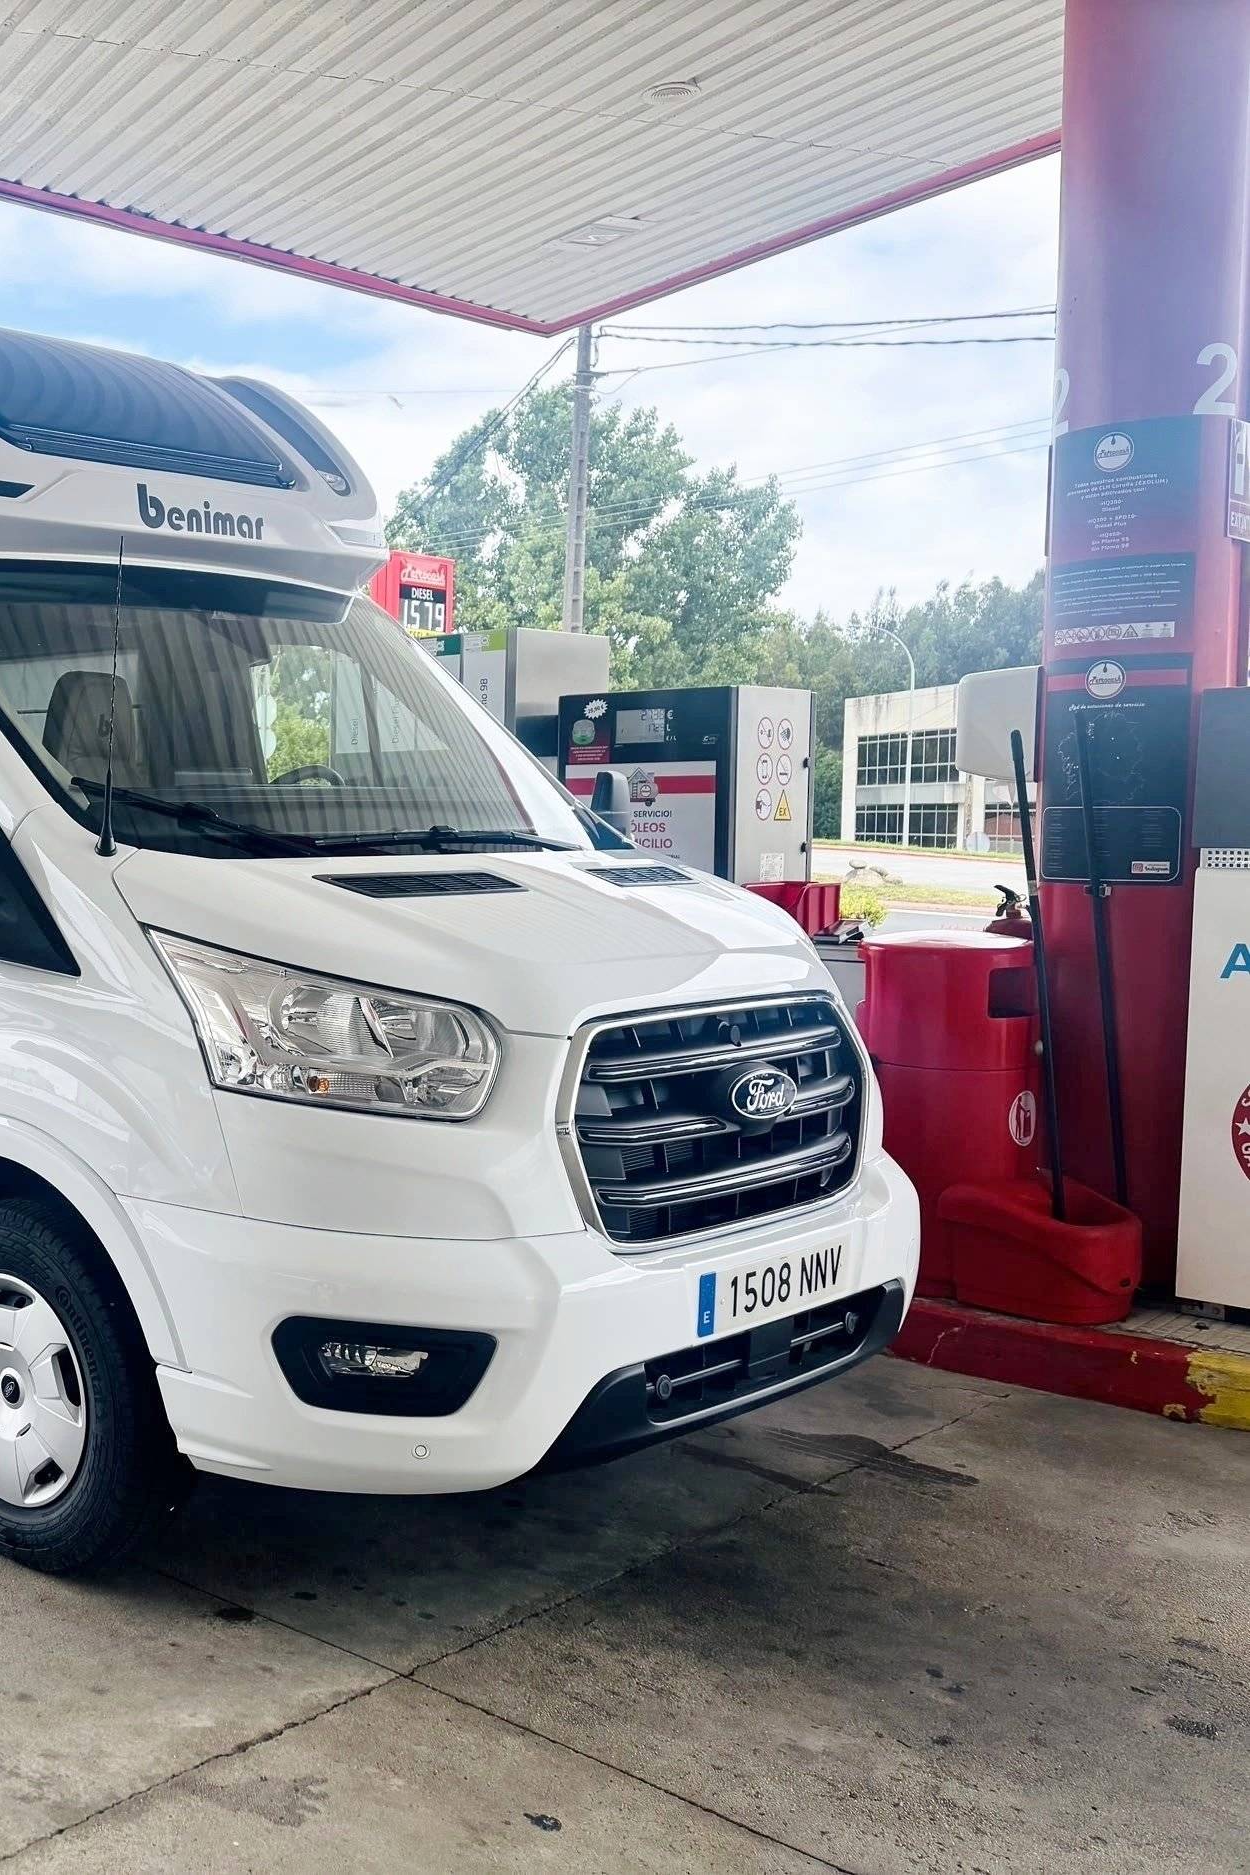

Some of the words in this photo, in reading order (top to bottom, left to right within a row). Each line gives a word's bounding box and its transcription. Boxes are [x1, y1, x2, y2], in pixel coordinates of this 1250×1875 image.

[1193, 342, 1237, 415] 2
[137, 483, 264, 541] benimar
[411, 587, 434, 600] DIESEL
[633, 810, 672, 818] SERVICIO!
[779, 808, 787, 817] EX
[746, 1078, 786, 1112] Ford
[703, 1310, 711, 1324] E
[730, 1262, 792, 1318] 1508
[800, 1244, 842, 1297] NNV
